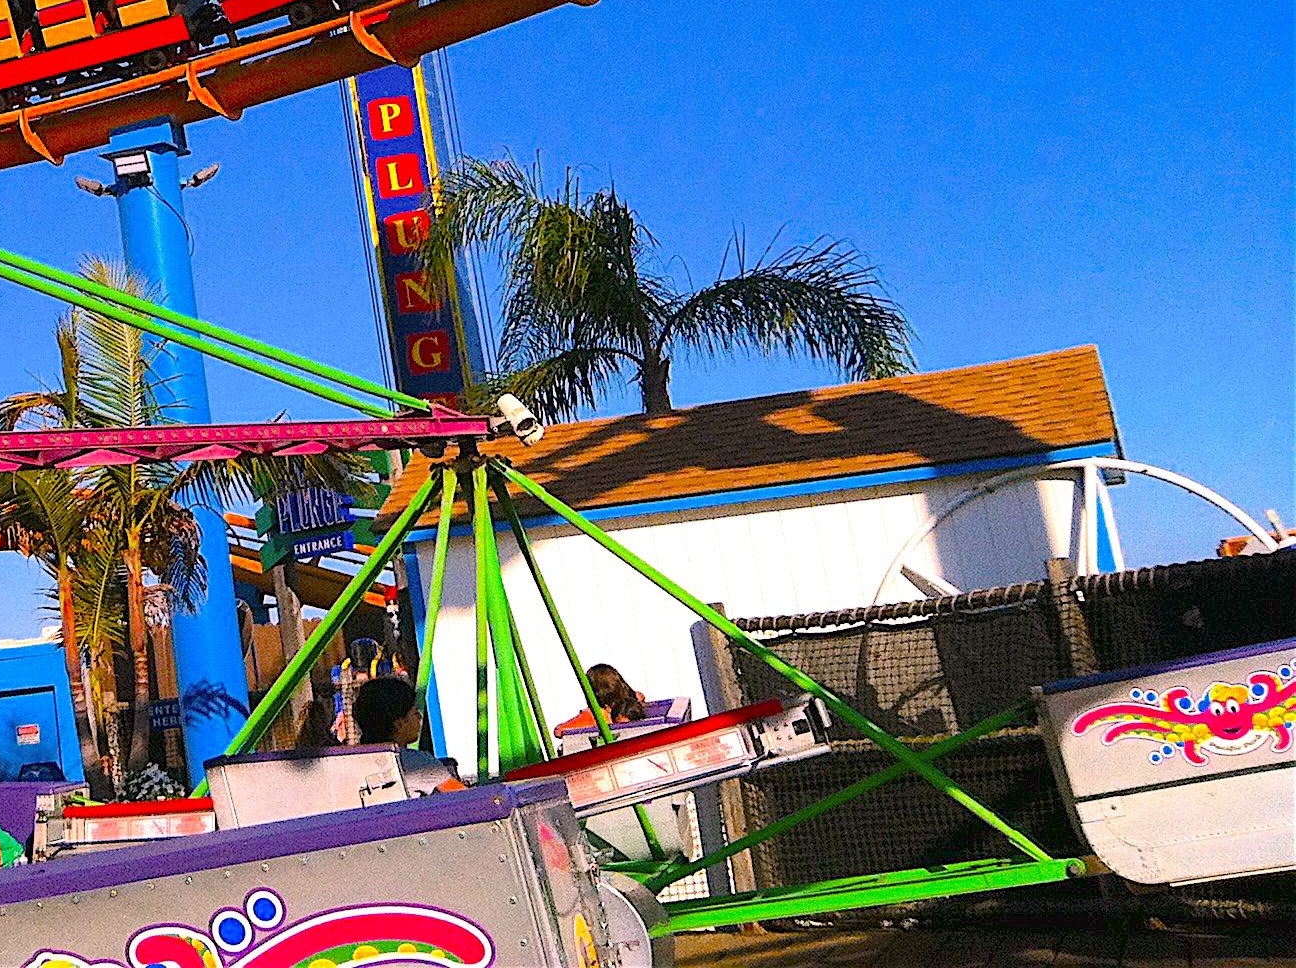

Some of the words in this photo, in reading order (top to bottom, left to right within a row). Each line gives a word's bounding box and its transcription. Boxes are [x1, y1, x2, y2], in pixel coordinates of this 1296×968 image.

[378, 103, 447, 406] PLUNG
[276, 486, 345, 534] PLUNGE
[293, 536, 343, 555] ENTRANCE
[148, 704, 179, 716] ENTE
[153, 716, 180, 727] HER
